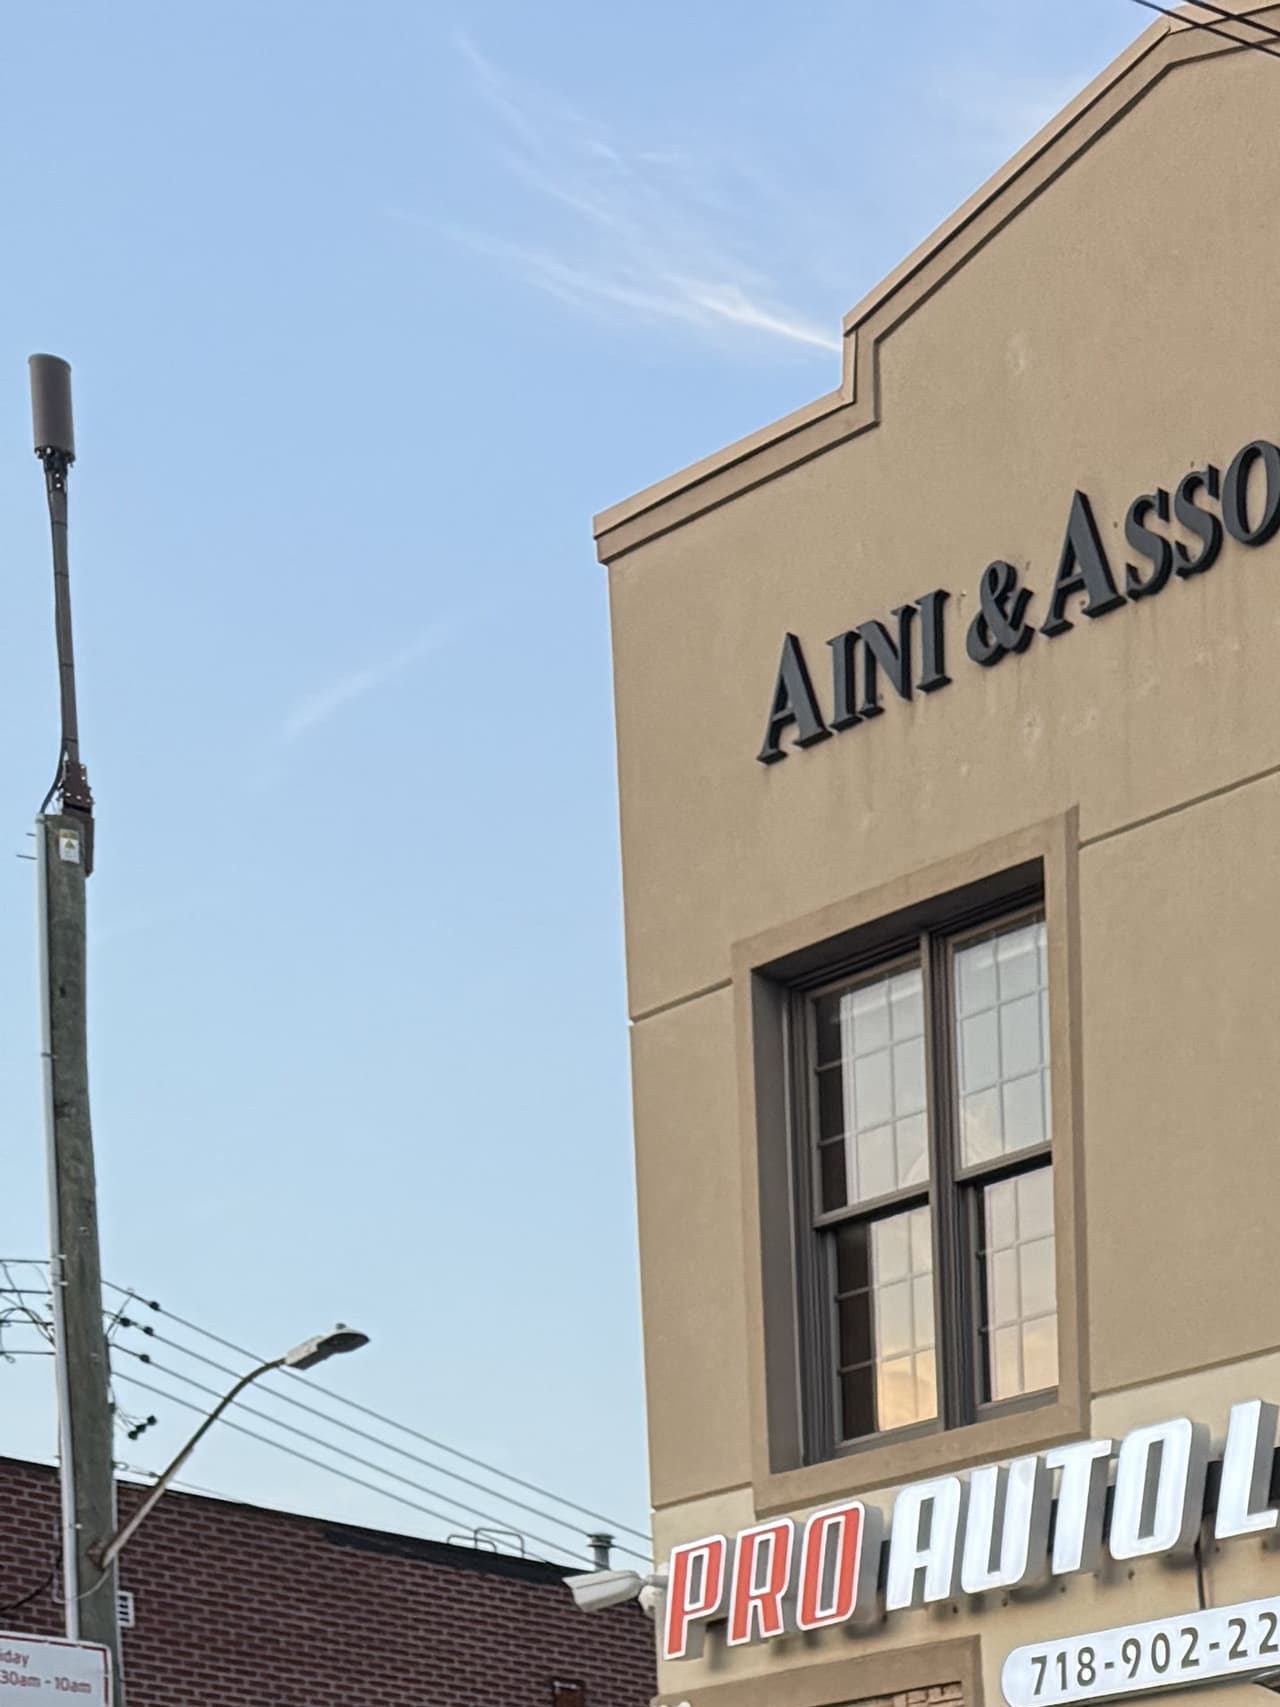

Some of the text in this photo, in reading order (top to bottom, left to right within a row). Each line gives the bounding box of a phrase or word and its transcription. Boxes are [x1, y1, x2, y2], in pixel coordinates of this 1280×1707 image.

[756, 588, 952, 765] AINI
[964, 558, 1037, 668] &
[663, 1500, 870, 1661] PRO
[886, 1416, 1200, 1612] AUTO
